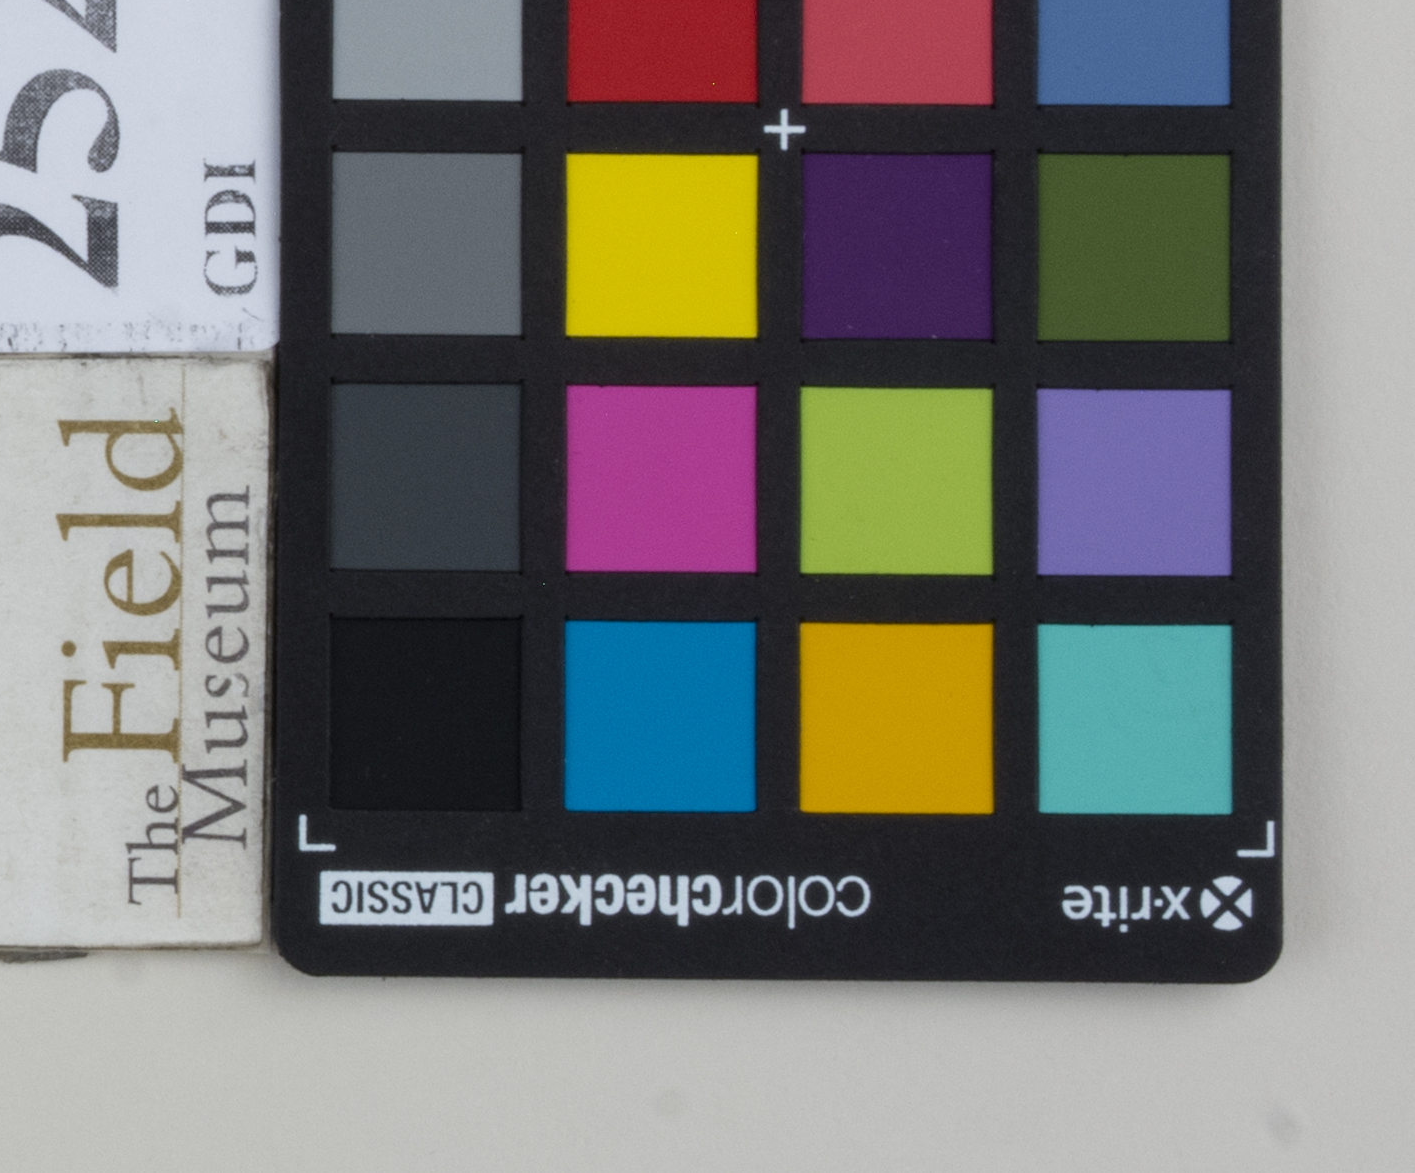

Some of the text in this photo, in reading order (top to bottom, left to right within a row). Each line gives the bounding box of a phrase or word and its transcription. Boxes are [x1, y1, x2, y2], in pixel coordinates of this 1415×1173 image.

[203, 160, 258, 298] GDI
[55, 407, 184, 906] The Field
[181, 484, 251, 850] Museum
[330, 872, 871, 930] colorchecker CLASSIC
